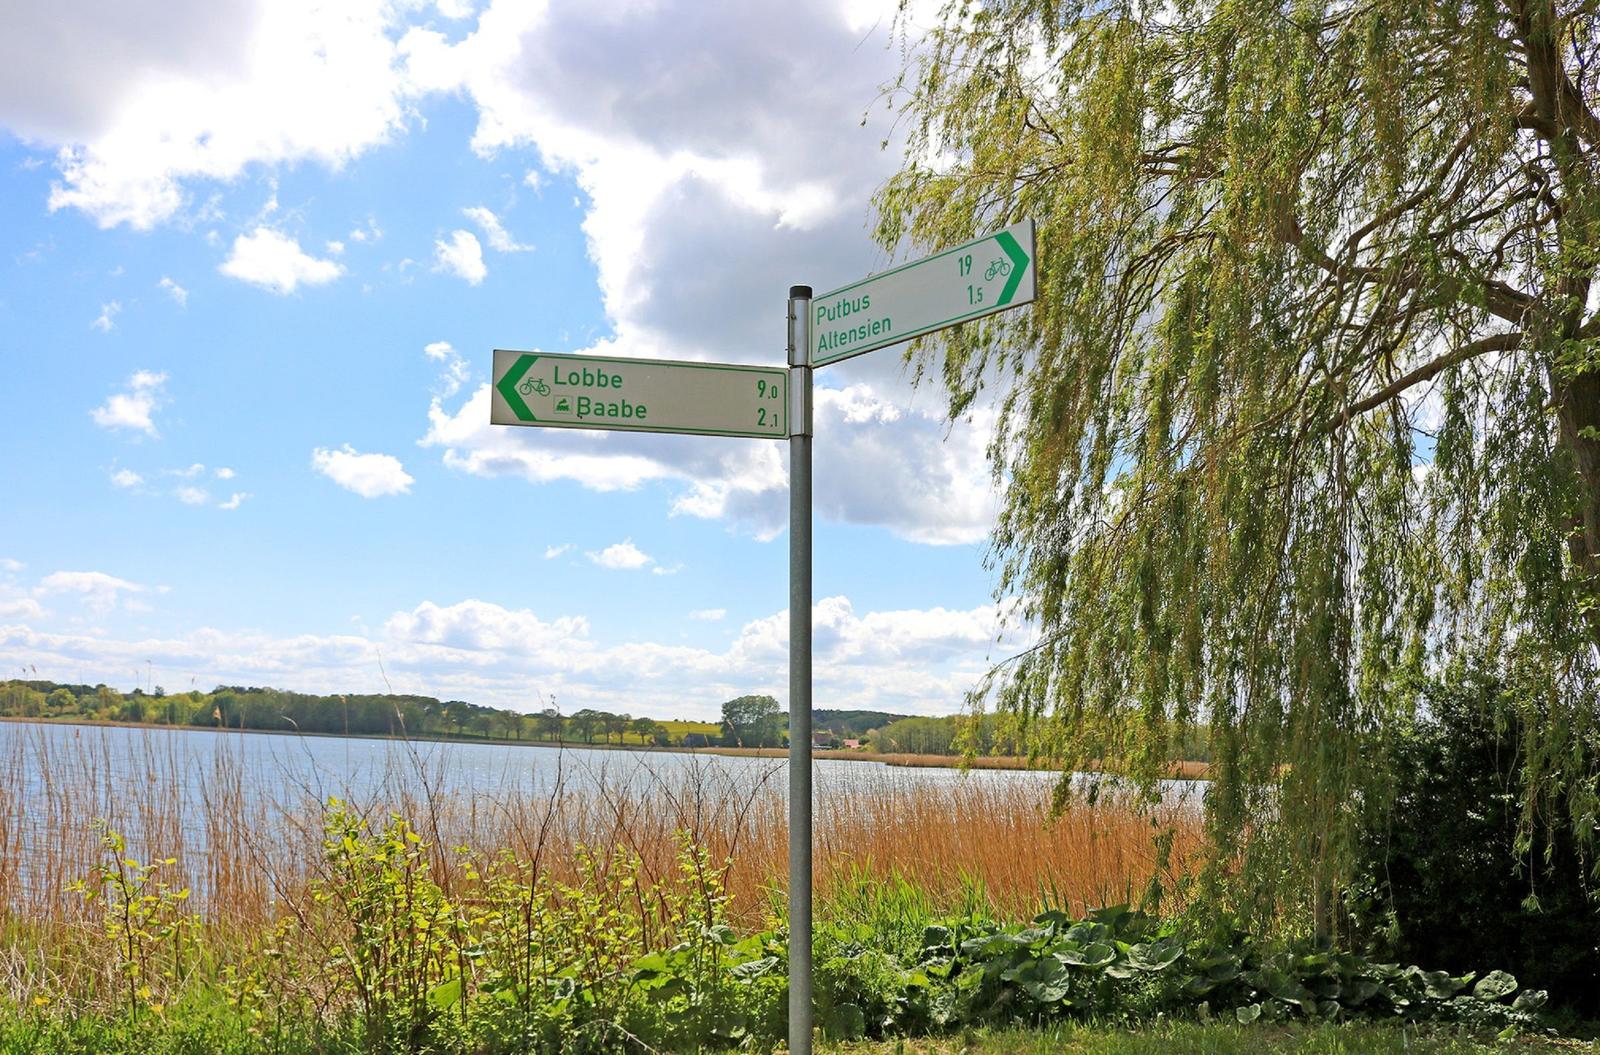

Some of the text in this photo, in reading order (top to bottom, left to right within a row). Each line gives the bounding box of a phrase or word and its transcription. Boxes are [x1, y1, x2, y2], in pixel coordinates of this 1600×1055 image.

[816, 255, 972, 325] Putbus 19
[817, 285, 983, 353] Altensien 1.5
[554, 365, 778, 399] Lobbe 9.0
[577, 396, 778, 428] Baabe 2.1
